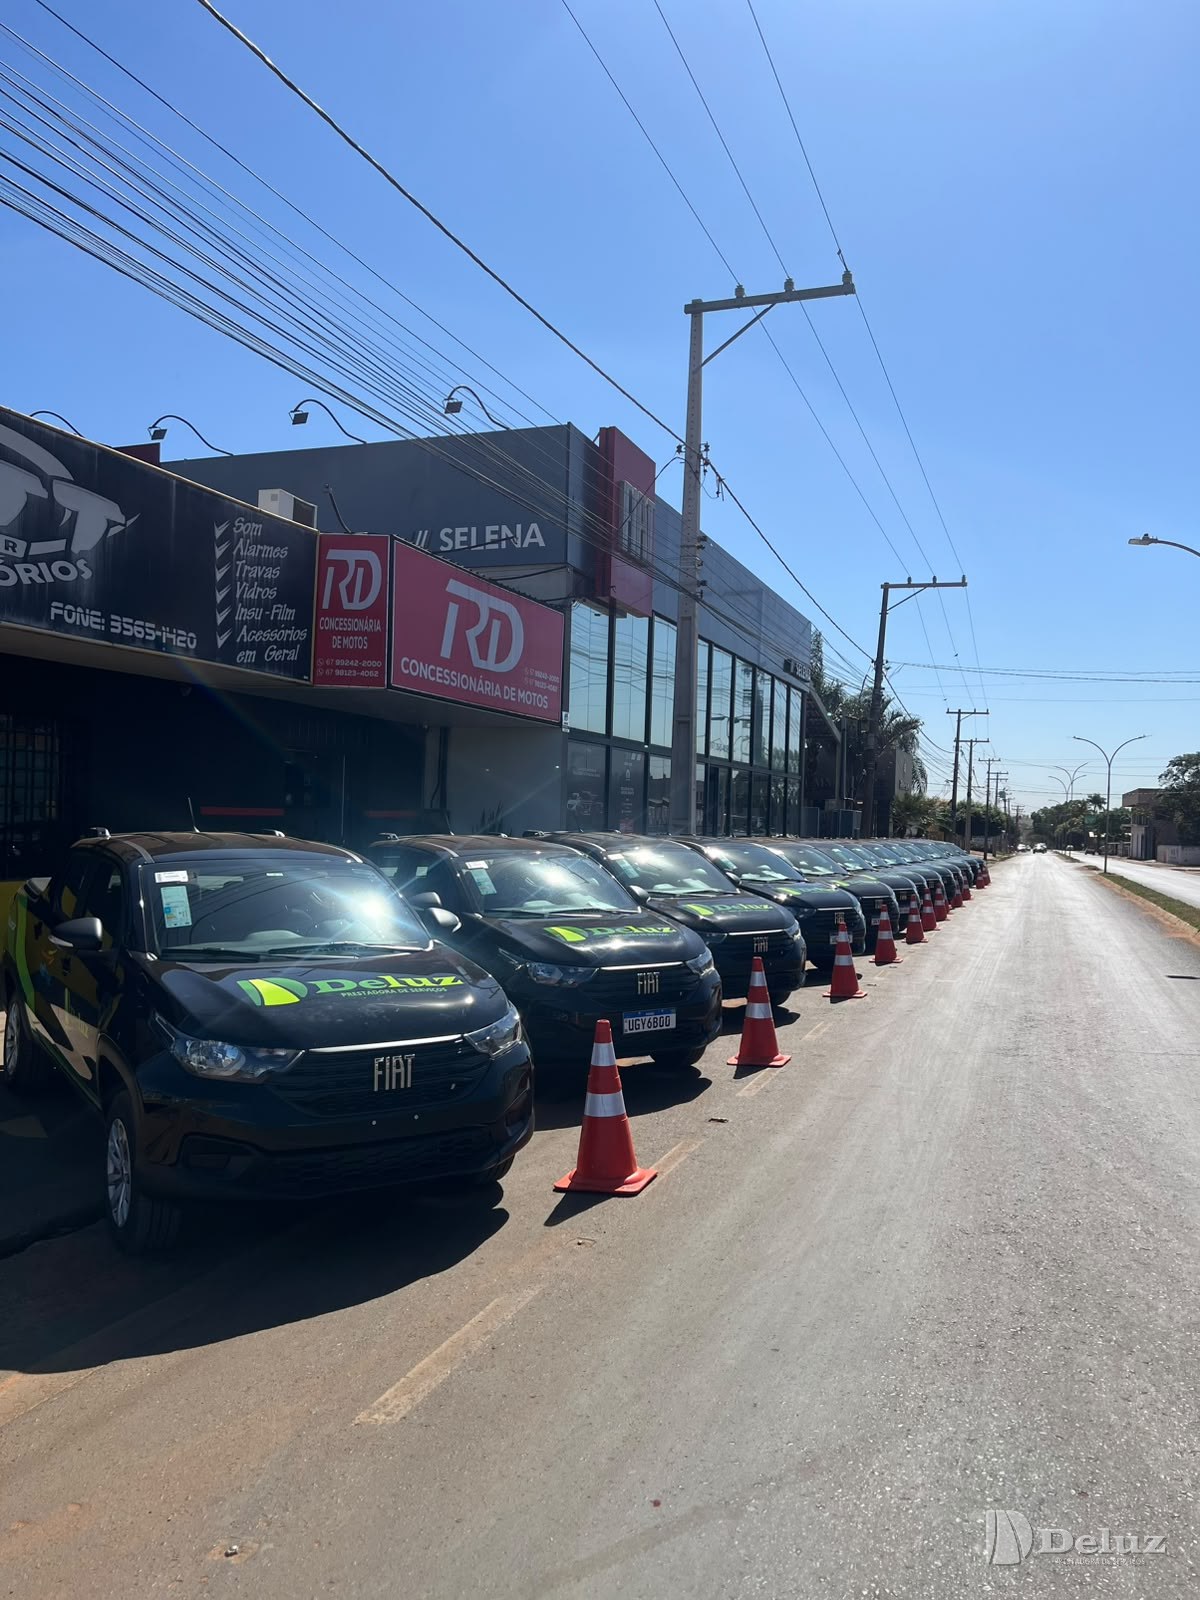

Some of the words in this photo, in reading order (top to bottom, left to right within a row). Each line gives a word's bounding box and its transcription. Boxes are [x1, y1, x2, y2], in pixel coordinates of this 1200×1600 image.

[233, 517, 262, 536] Som
[440, 523, 545, 551] SELENA
[233, 538, 288, 558] Alarmes
[235, 560, 280, 579] Travas
[235, 582, 277, 600] Vidros
[50, 601, 105, 631] FONE:
[110, 614, 197, 650] 3565-1420
[319, 615, 381, 632] CONCESSIONÁRIA
[236, 624, 307, 643] Acessórios
[332, 635, 342, 649] DE
[343, 636, 368, 650] MOTOS
[236, 651, 255, 663] em
[264, 645, 300, 661] Geral
[401, 656, 502, 698] CONCESSIONÁRIA
[503, 685, 516, 701] DE
[518, 688, 548, 709] MOTOS
[586, 925, 677, 936] Deluz
[306, 975, 464, 994] Deluz
[341, 988, 398, 997] PRESTADORA
[637, 971, 660, 995] FIAT
[628, 1015, 671, 1031] UGY6B00
[374, 1054, 415, 1092] FIAT
